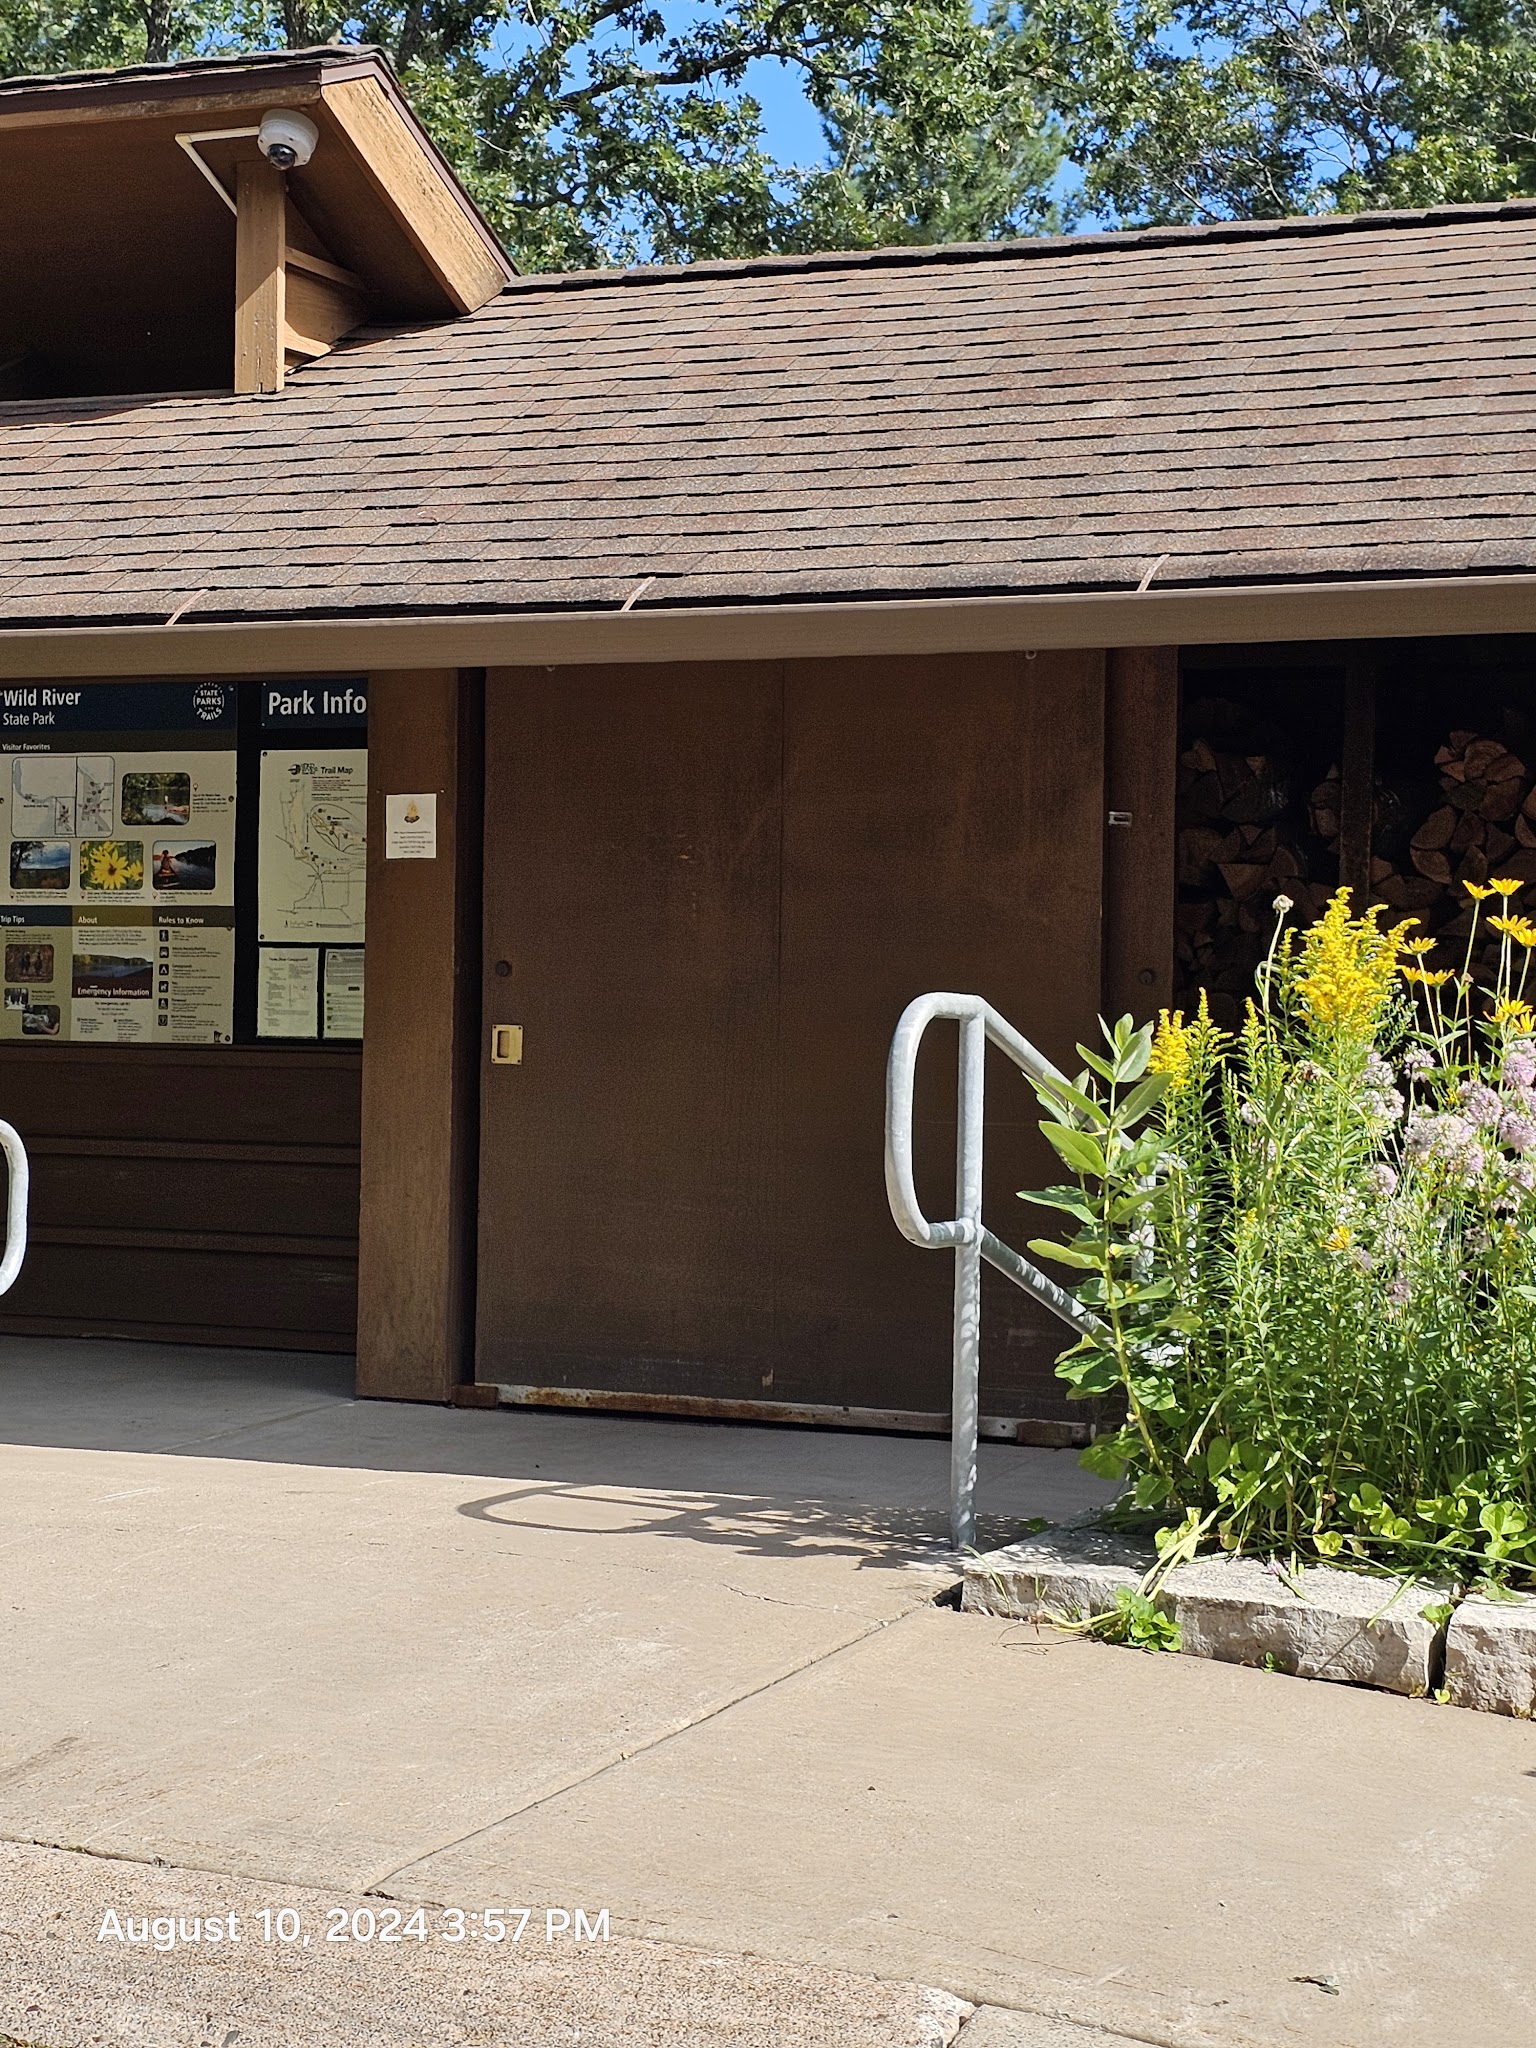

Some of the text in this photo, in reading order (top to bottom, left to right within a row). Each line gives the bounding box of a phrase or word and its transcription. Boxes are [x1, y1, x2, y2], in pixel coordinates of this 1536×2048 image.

[3, 688, 81, 707] Wild River
[196, 697, 222, 705] PARKS
[268, 688, 367, 716] Park Info
[3, 711, 55, 725] State Park
[196, 707, 223, 721] TRAILS
[2, 743, 51, 751] Visitor Favorites
[320, 766, 336, 774] Trail
[337, 766, 354, 776] Map
[0, 915, 25, 924] Trip Tips
[78, 916, 98, 924] About
[158, 916, 177, 924] Rules
[185, 916, 204, 924] Know
[77, 987, 150, 998] Emergency Information
